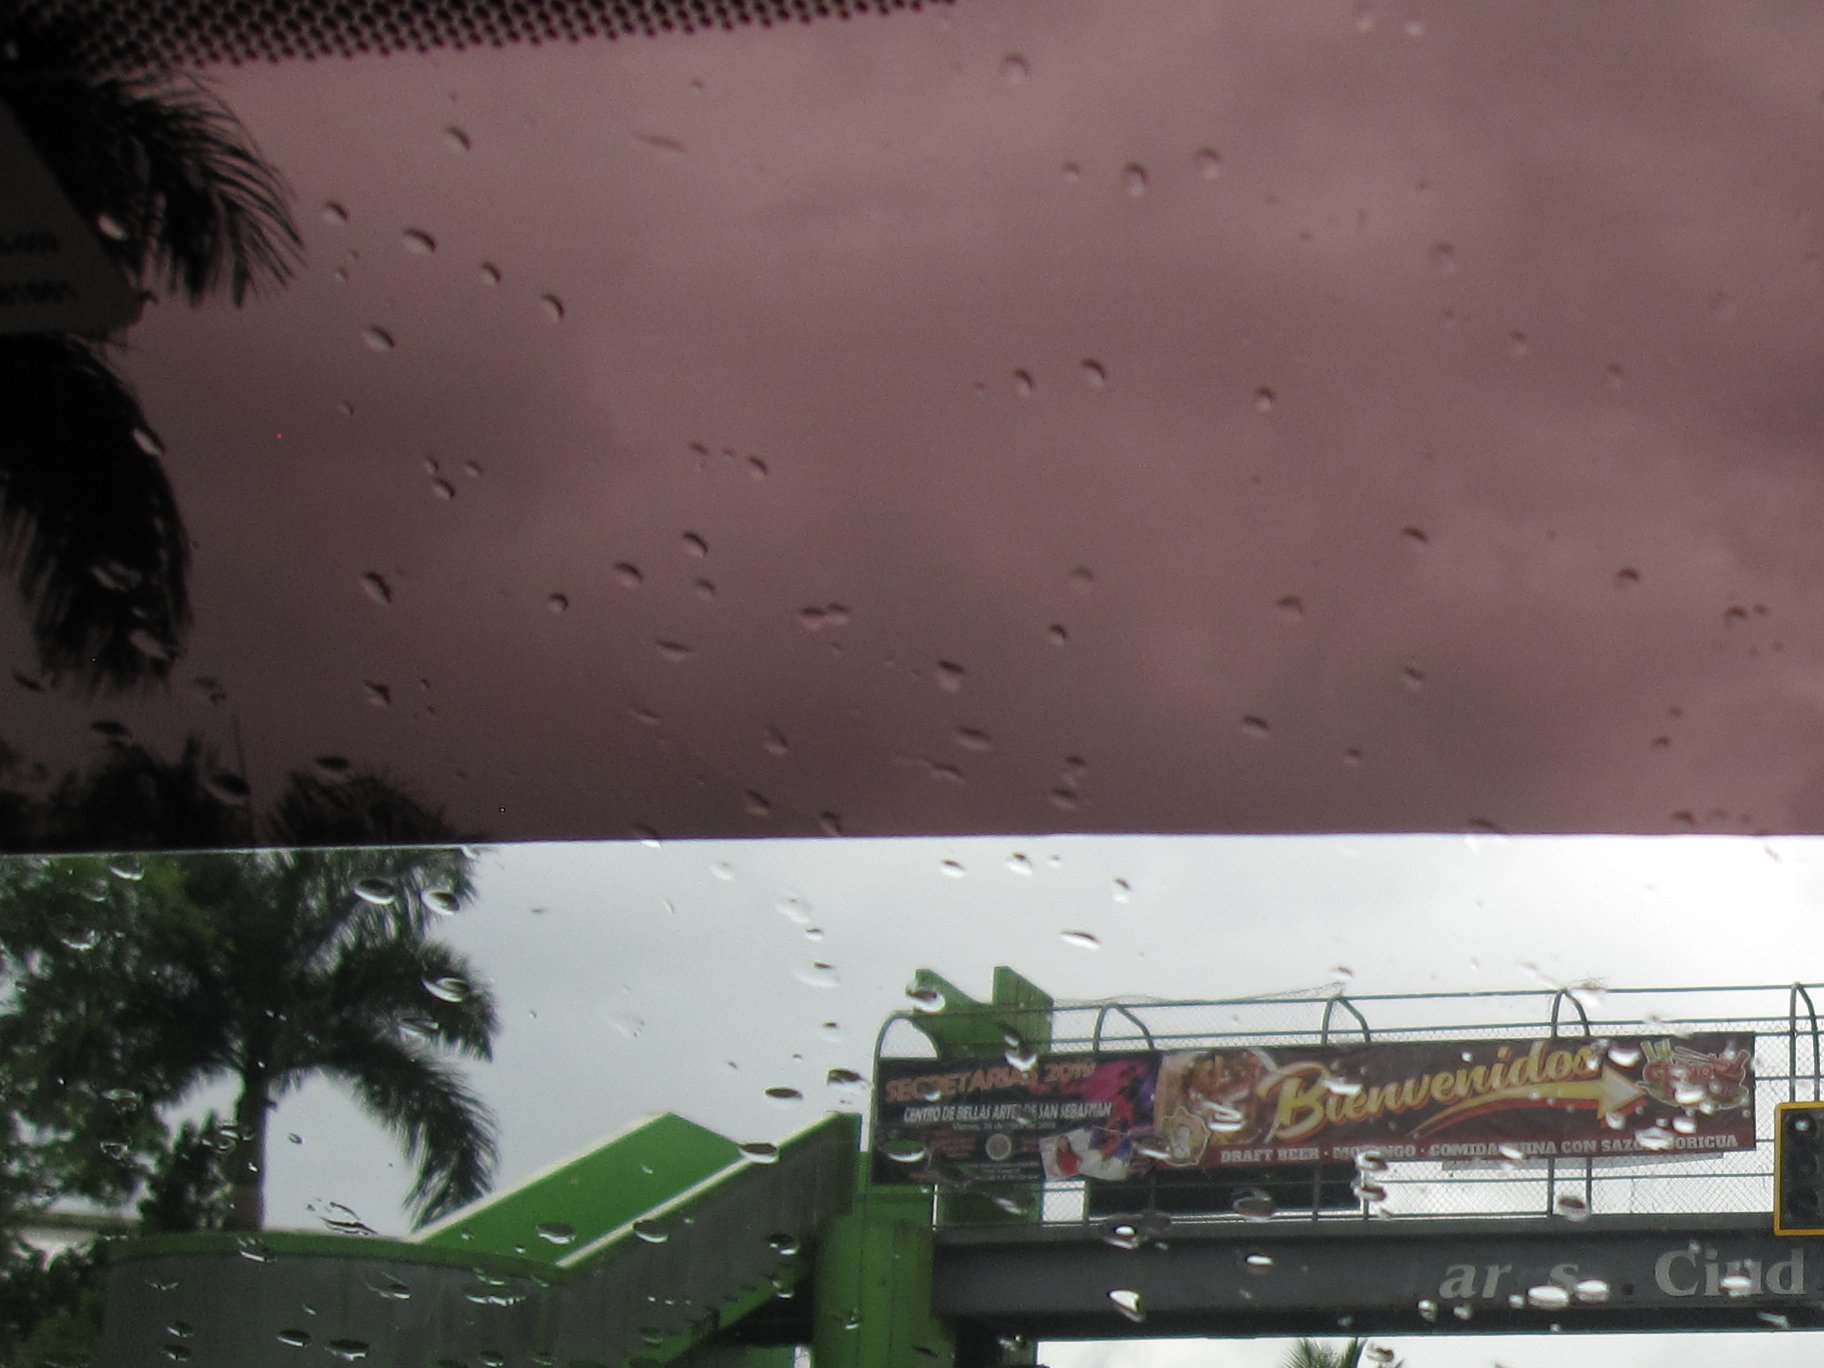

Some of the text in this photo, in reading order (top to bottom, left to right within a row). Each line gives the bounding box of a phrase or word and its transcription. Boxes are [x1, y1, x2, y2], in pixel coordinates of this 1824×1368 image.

[1257, 1040, 1600, 1144] Bienvenidos
[1220, 1148, 1273, 1163] DRAFT
[1277, 1147, 1320, 1161] BEER
[1561, 1139, 1596, 1154] CON
[1666, 1134, 1738, 1150] ORICUA
